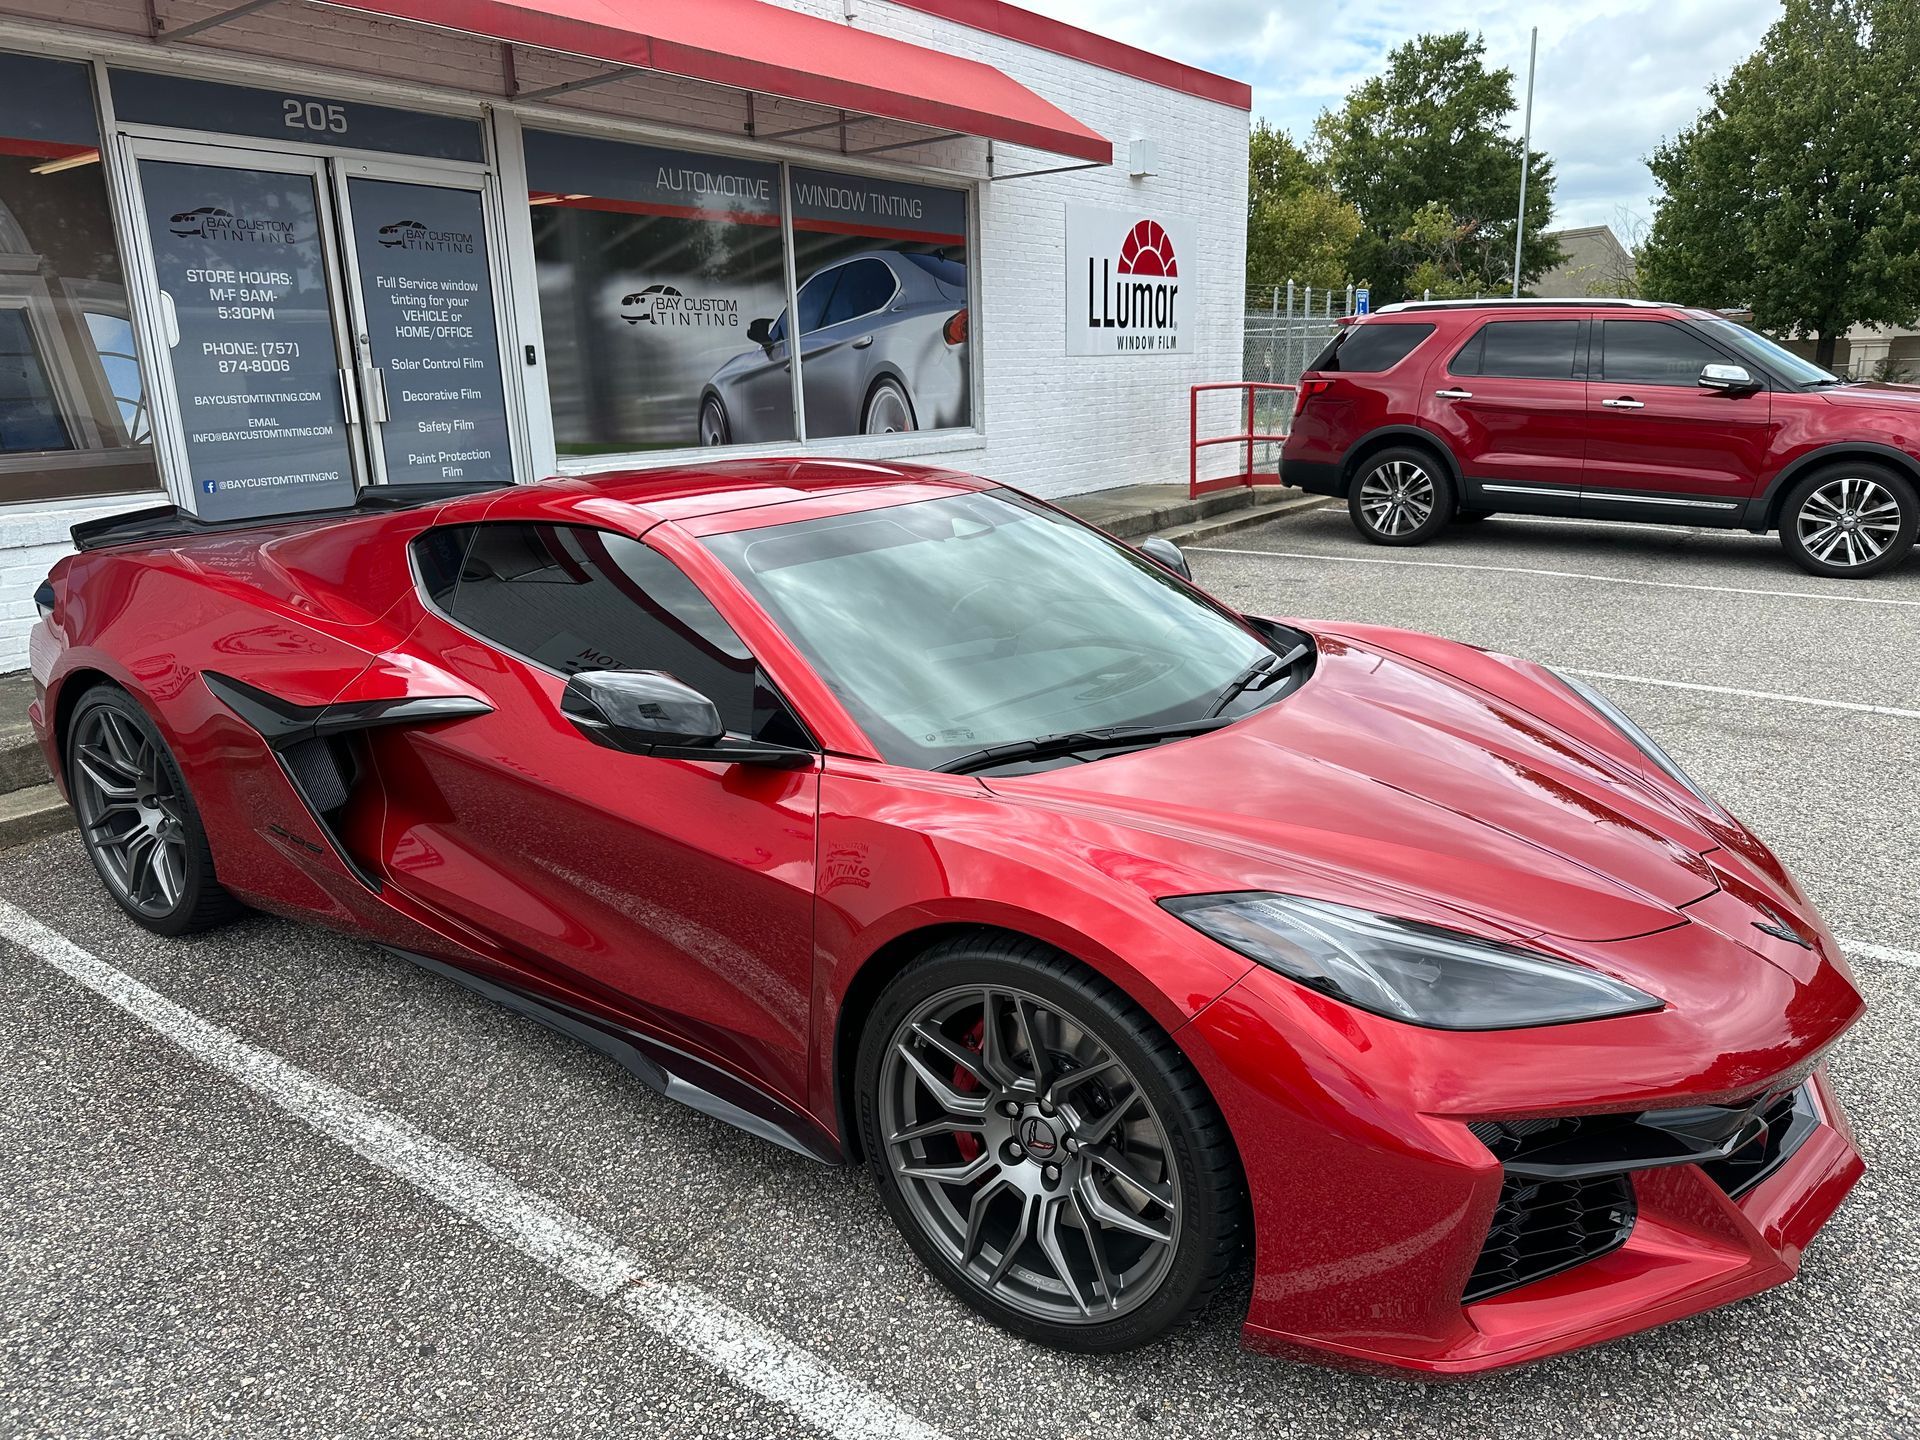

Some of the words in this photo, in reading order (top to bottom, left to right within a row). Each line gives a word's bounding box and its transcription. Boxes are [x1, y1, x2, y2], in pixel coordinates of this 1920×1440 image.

[283, 99, 347, 133] 205
[656, 167, 770, 200] AUTOMOTIVE
[796, 182, 866, 212] WINDOW
[870, 193, 922, 219] TINTING
[206, 216, 233, 228] BAY
[236, 219, 294, 232] CUSTOM
[208, 229, 295, 244] TINTING
[406, 230, 426, 239] BAY
[429, 232, 472, 243] CUSTOM
[408, 240, 474, 254] TINTING
[186, 270, 236, 283] STORE
[239, 272, 293, 285] HOURS:
[376, 276, 396, 288] Full
[398, 277, 438, 290] Service
[440, 280, 478, 292] window
[210, 288, 236, 301] M-F
[240, 289, 278, 302] 9AM-
[1089, 257, 1178, 329] LLumar
[391, 294, 426, 308] tinting
[428, 295, 444, 306] for
[446, 298, 469, 309] your
[656, 297, 682, 310] BAY
[684, 298, 738, 312] CUSTOM
[218, 307, 275, 320] 5:30PM
[402, 310, 449, 322] VEHICLE
[451, 313, 462, 322] or
[658, 312, 738, 327] TINTING
[396, 326, 473, 340] HOME/OFFICE
[202, 342, 258, 355] PHONE:
[262, 342, 300, 358] (757)
[1117, 336, 1154, 350] WINDOW
[1158, 336, 1177, 350] FILM
[218, 360, 290, 373] 874-8006
[391, 358, 420, 370] Solar
[422, 358, 461, 370] Control
[463, 358, 484, 368] Film
[194, 392, 322, 406] BAYCUSTOMTINTING.COM
[402, 389, 459, 402] Decorative
[460, 388, 482, 399] Film
[248, 418, 279, 428] EMAIL
[418, 421, 452, 434] Safety
[454, 420, 474, 430] Film
[192, 426, 333, 443] INFO@BAYCUSTOMTINTING.COM
[408, 453, 437, 465] Paint
[438, 449, 491, 462] Protection
[442, 466, 463, 478] Film
[219, 472, 338, 490] @BAYCUSTOMTINTINGNC
